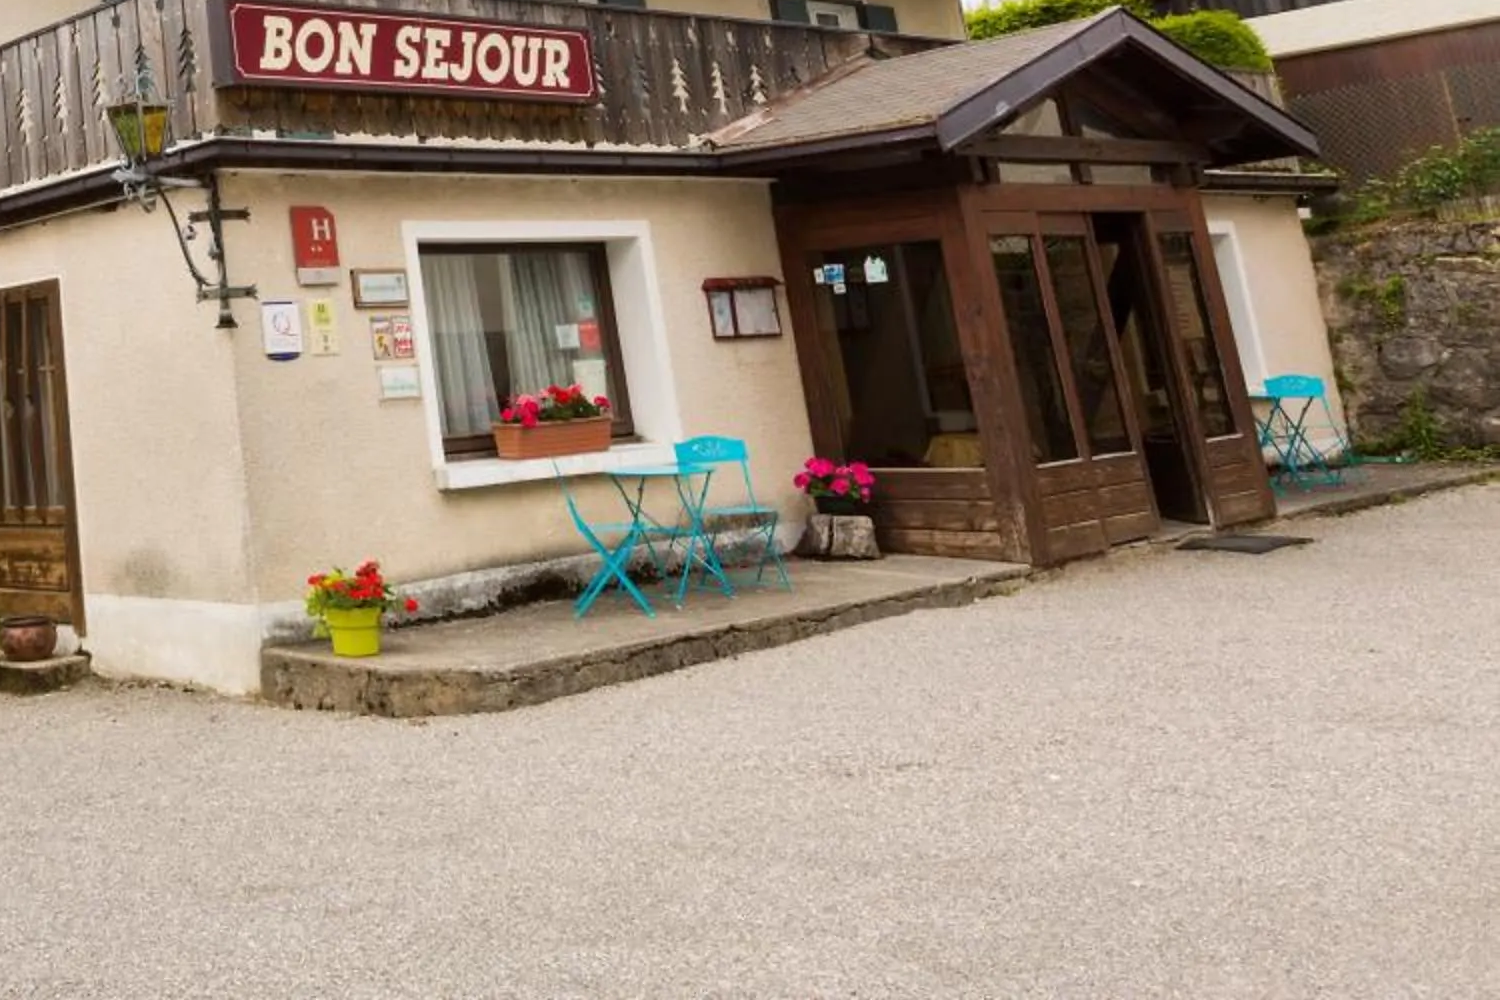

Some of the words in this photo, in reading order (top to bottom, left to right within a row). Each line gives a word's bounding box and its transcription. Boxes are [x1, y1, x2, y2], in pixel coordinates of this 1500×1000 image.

[259, 14, 377, 76] BON
[393, 25, 571, 88] SEJOUR
[311, 217, 332, 241] H
